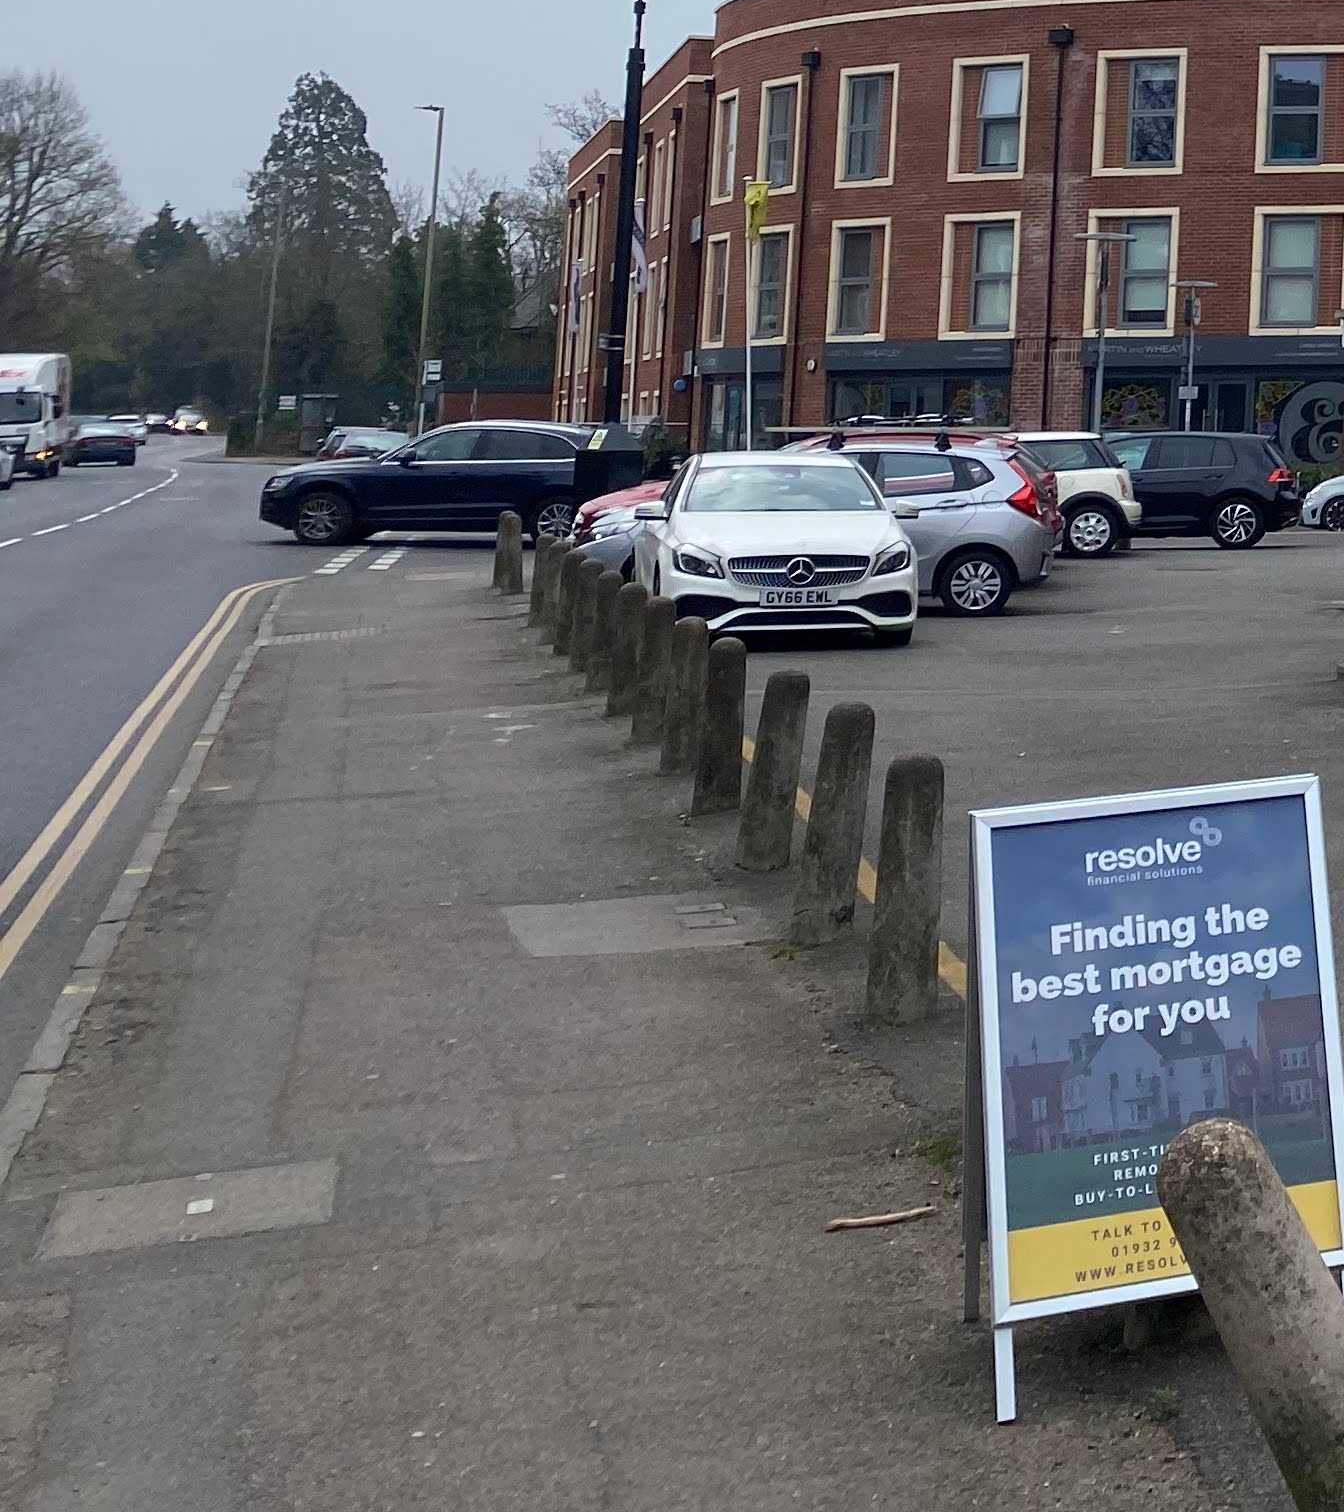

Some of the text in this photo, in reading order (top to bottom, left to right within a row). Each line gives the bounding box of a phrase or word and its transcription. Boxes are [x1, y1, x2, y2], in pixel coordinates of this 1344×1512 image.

[766, 591, 802, 604] GY66
[1085, 838, 1201, 873] resolve
[1087, 864, 1203, 887] financial solutions
[1051, 903, 1269, 956] Finding the
[1011, 944, 1302, 1003] best mortgage
[1092, 996, 1231, 1036] for you
[1093, 1144, 1165, 1166] FIRST-TI
[1114, 1164, 1159, 1181] REMO
[1074, 1183, 1153, 1206] BUY-TO-L
[1091, 1220, 1162, 1241] TALK TO
[1111, 1239, 1161, 1258] 01932
